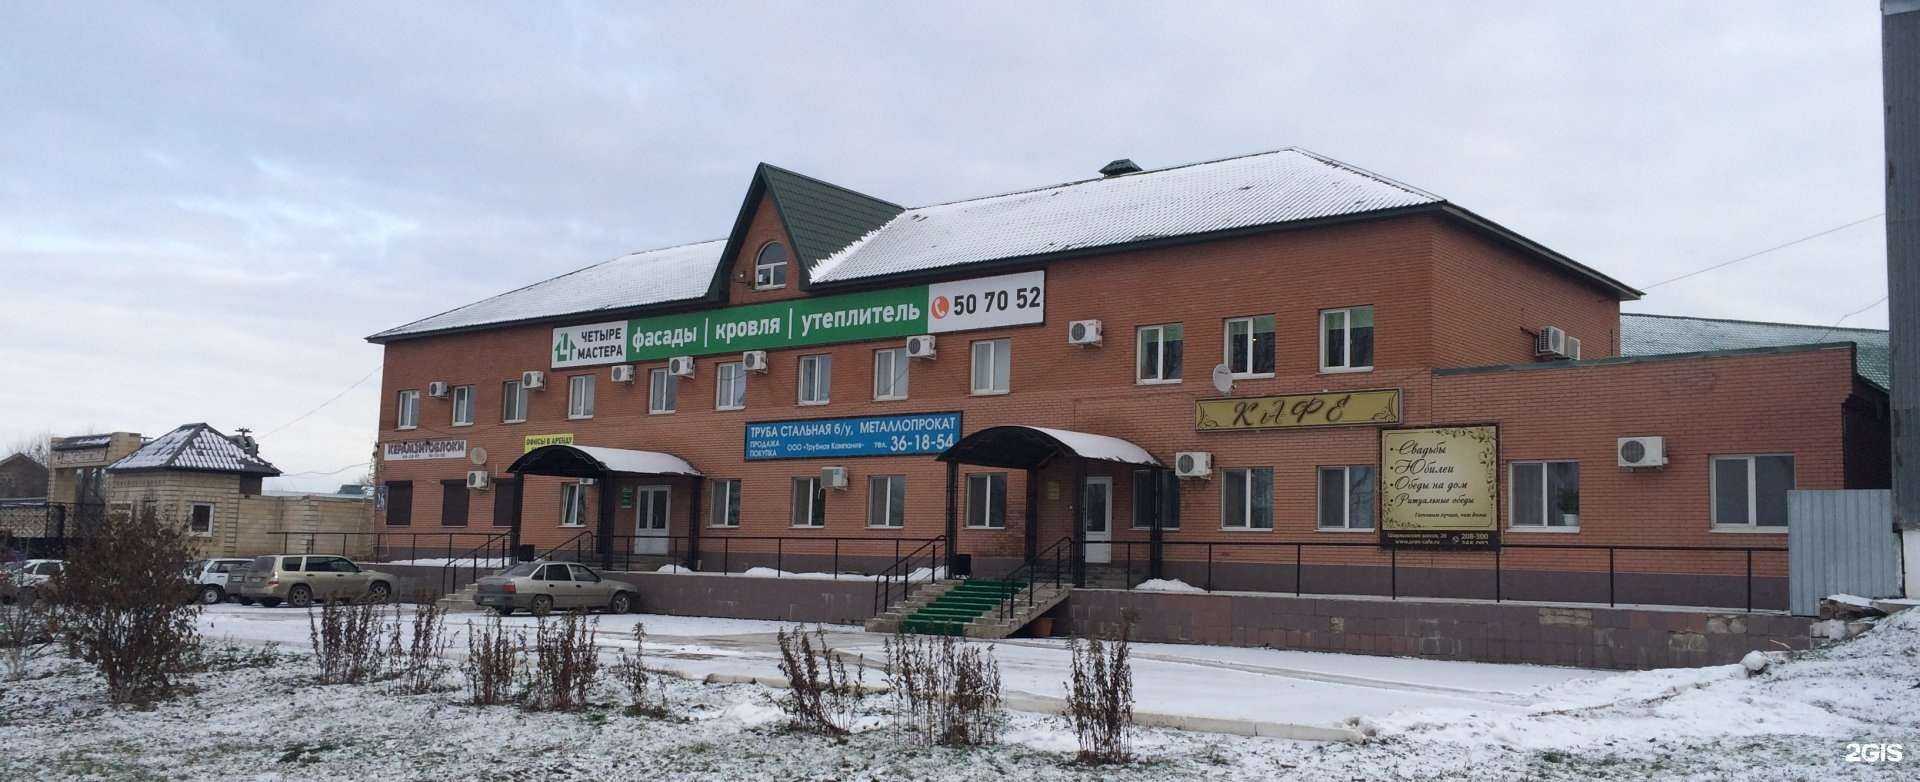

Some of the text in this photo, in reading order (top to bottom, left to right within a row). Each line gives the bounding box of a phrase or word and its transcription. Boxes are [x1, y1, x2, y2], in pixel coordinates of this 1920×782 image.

[953, 286, 1041, 316] 50 70 52
[581, 327, 622, 343] ЧЕТЫРЕ
[632, 303, 920, 353] фасады кровля утеплитель
[577, 344, 623, 360] МАСТЕРА
[1232, 394, 1351, 426] КАФЕ
[750, 425, 778, 438] ТРУБА
[780, 423, 832, 437] СТАЛЬНАЯ
[859, 416, 956, 434] МЕТАЛЛОПРОКАТ
[387, 440, 465, 455] КЕРАМЗИТОБЛОКИ
[749, 440, 780, 449] ПРОДАЖА
[786, 443, 802, 452] ООО
[890, 433, 954, 452] 36-18-54
[1398, 440, 1447, 458] Свадьбы
[749, 449, 777, 457] ПОКУПКА
[1394, 459, 1454, 475] Юбилеи
[1394, 475, 1430, 493] Обеды
[1447, 482, 1468, 493] дом
[1394, 492, 1474, 507] Ритуальные обеды
